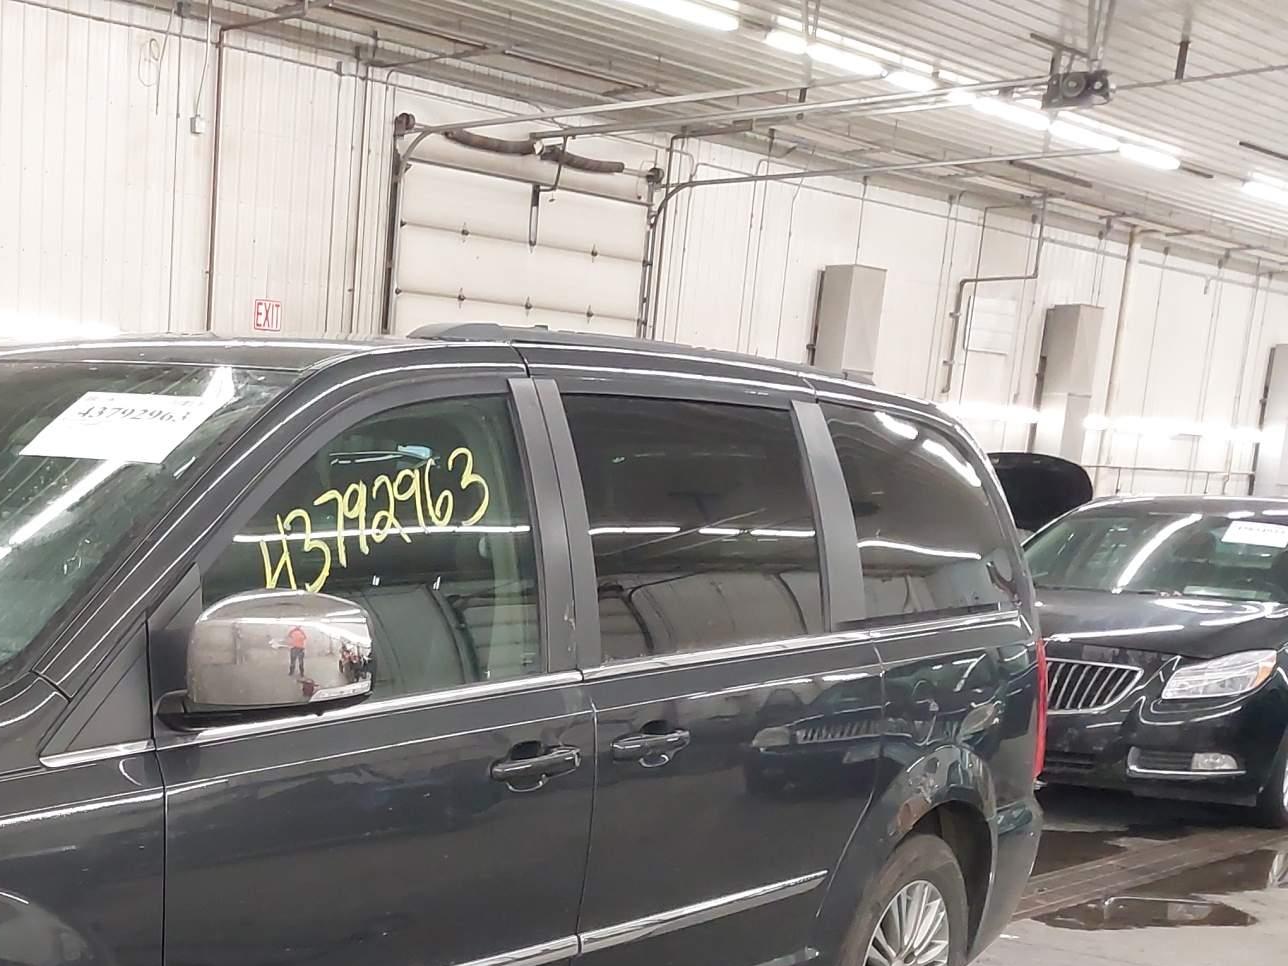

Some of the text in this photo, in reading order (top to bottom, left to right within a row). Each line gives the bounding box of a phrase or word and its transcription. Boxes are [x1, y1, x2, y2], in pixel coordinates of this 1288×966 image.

[256, 302, 280, 328] EXIT
[78, 405, 191, 422] 43792963
[260, 447, 489, 593] 43792963
